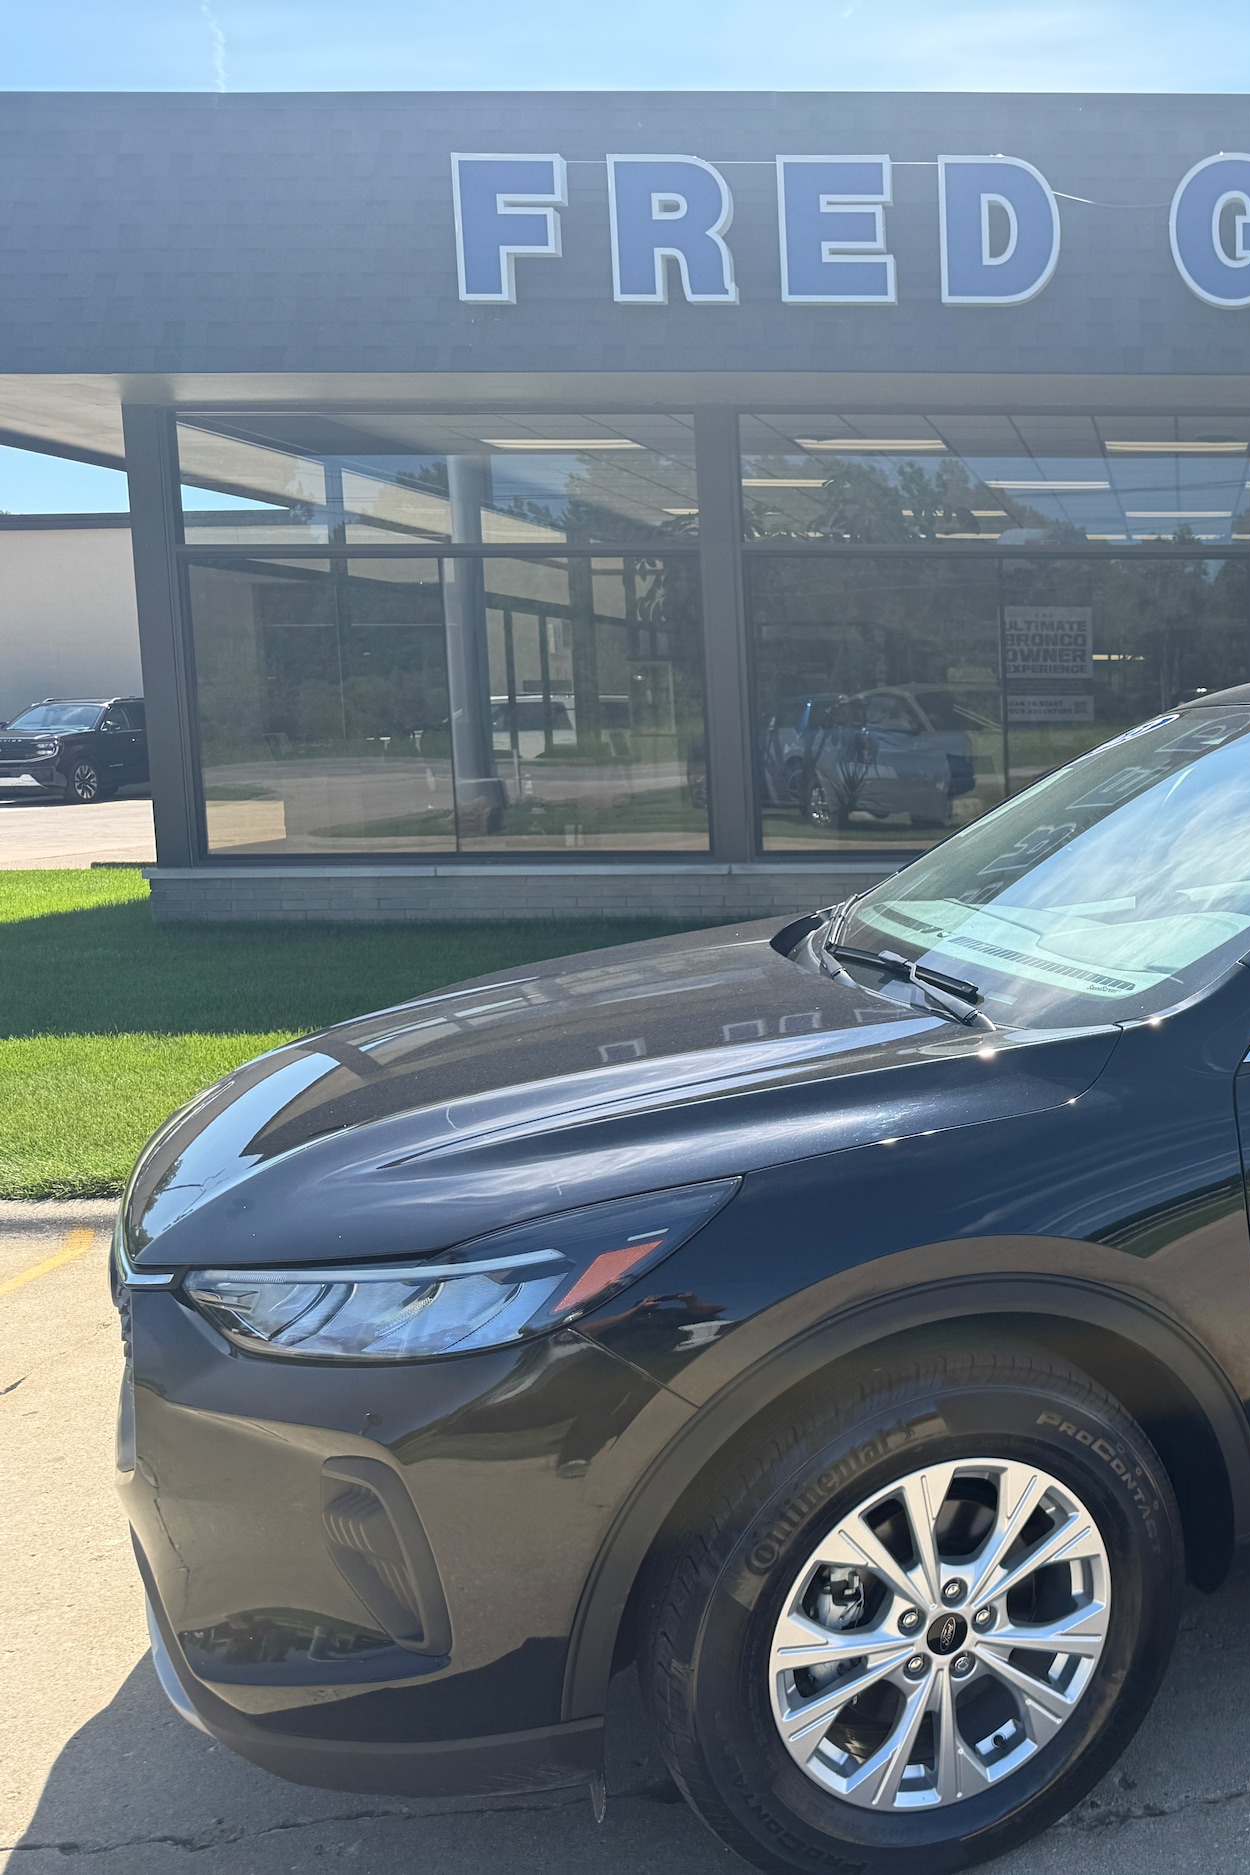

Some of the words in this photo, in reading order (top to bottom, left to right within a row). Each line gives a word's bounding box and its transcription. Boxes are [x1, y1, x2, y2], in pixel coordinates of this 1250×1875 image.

[450, 152, 1061, 306] FRED
[1005, 633, 1088, 647] BRONCO
[1005, 648, 1088, 662] OWNER
[1005, 664, 1088, 673] EXPERIENCE
